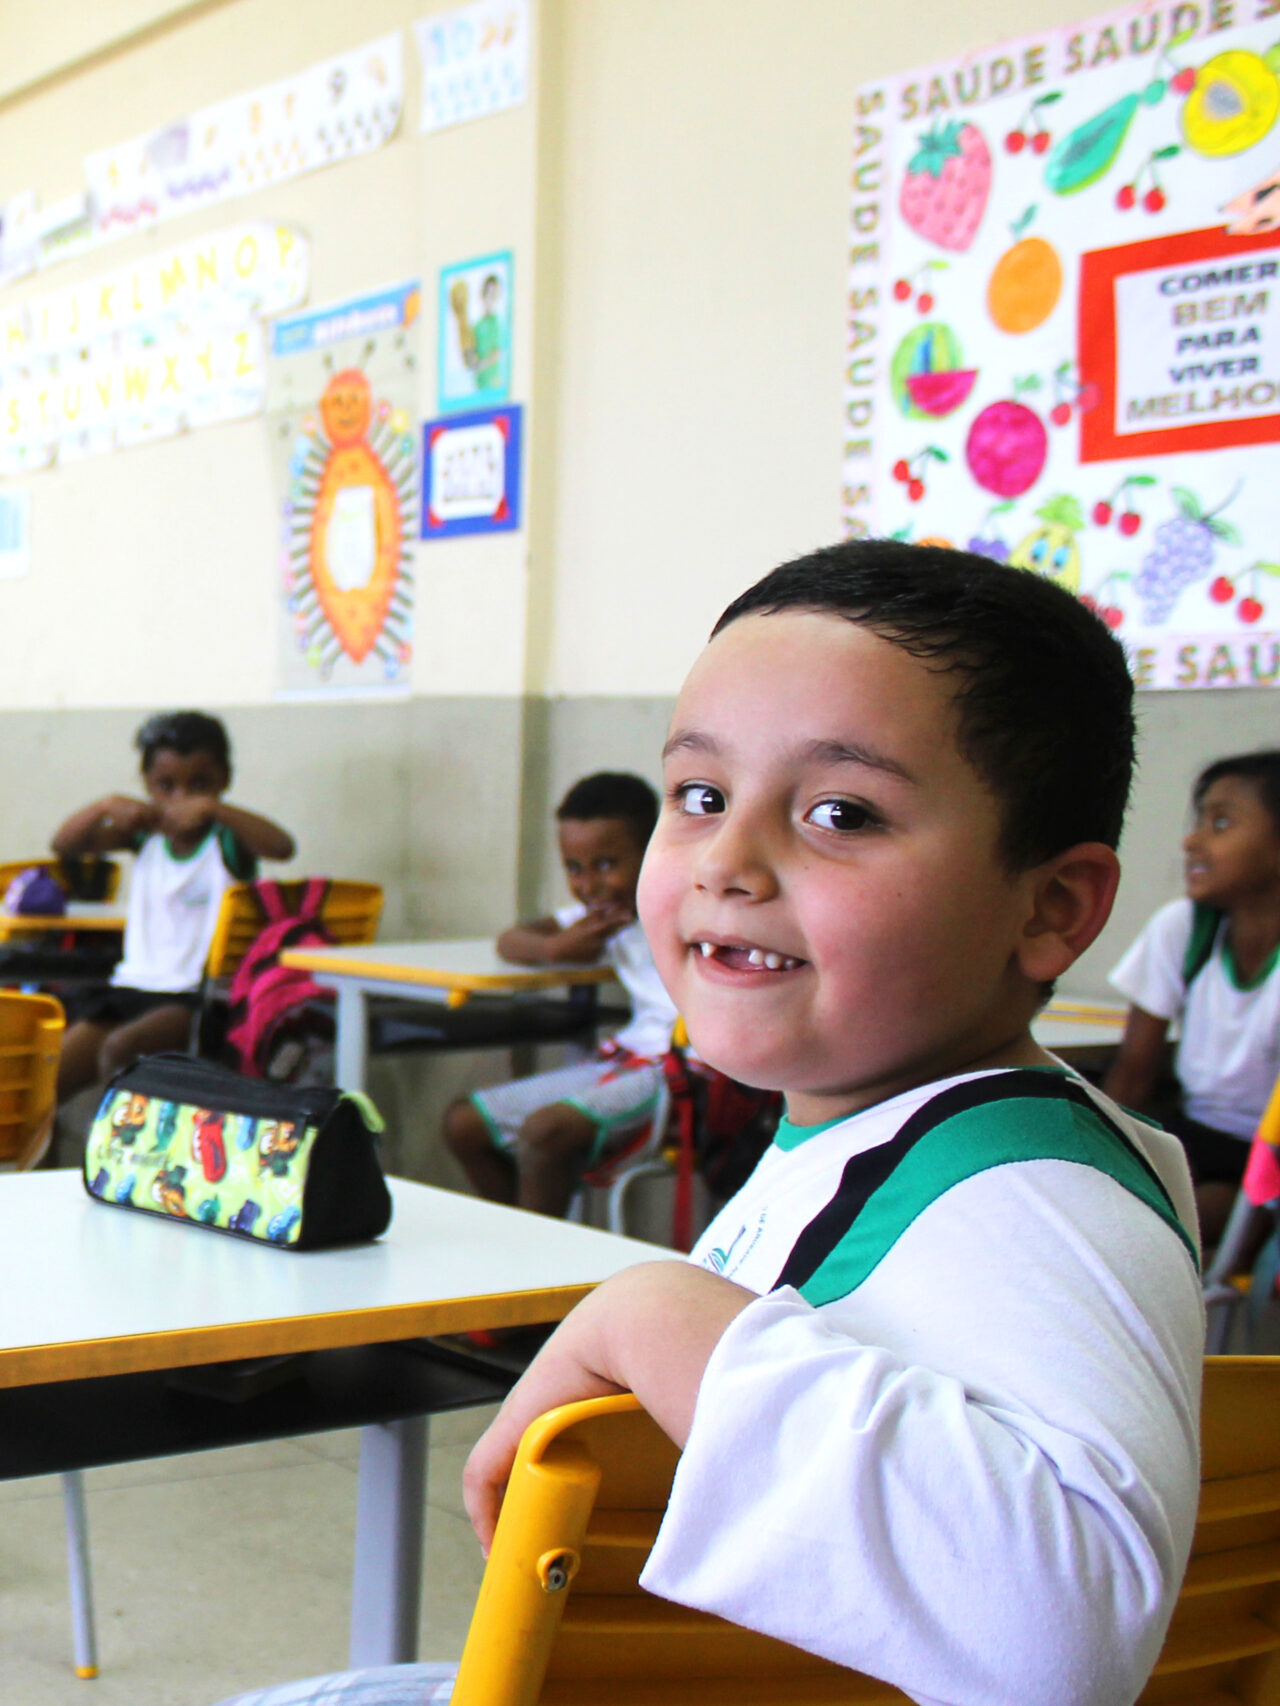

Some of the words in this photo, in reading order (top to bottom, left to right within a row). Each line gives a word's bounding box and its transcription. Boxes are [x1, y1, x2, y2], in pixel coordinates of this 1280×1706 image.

[1160, 260, 1279, 296] COMER
[1173, 289, 1269, 328] BEM
[1177, 325, 1260, 354] PARA
[1169, 355, 1260, 383] VIVER
[1126, 379, 1280, 423] MELHO
